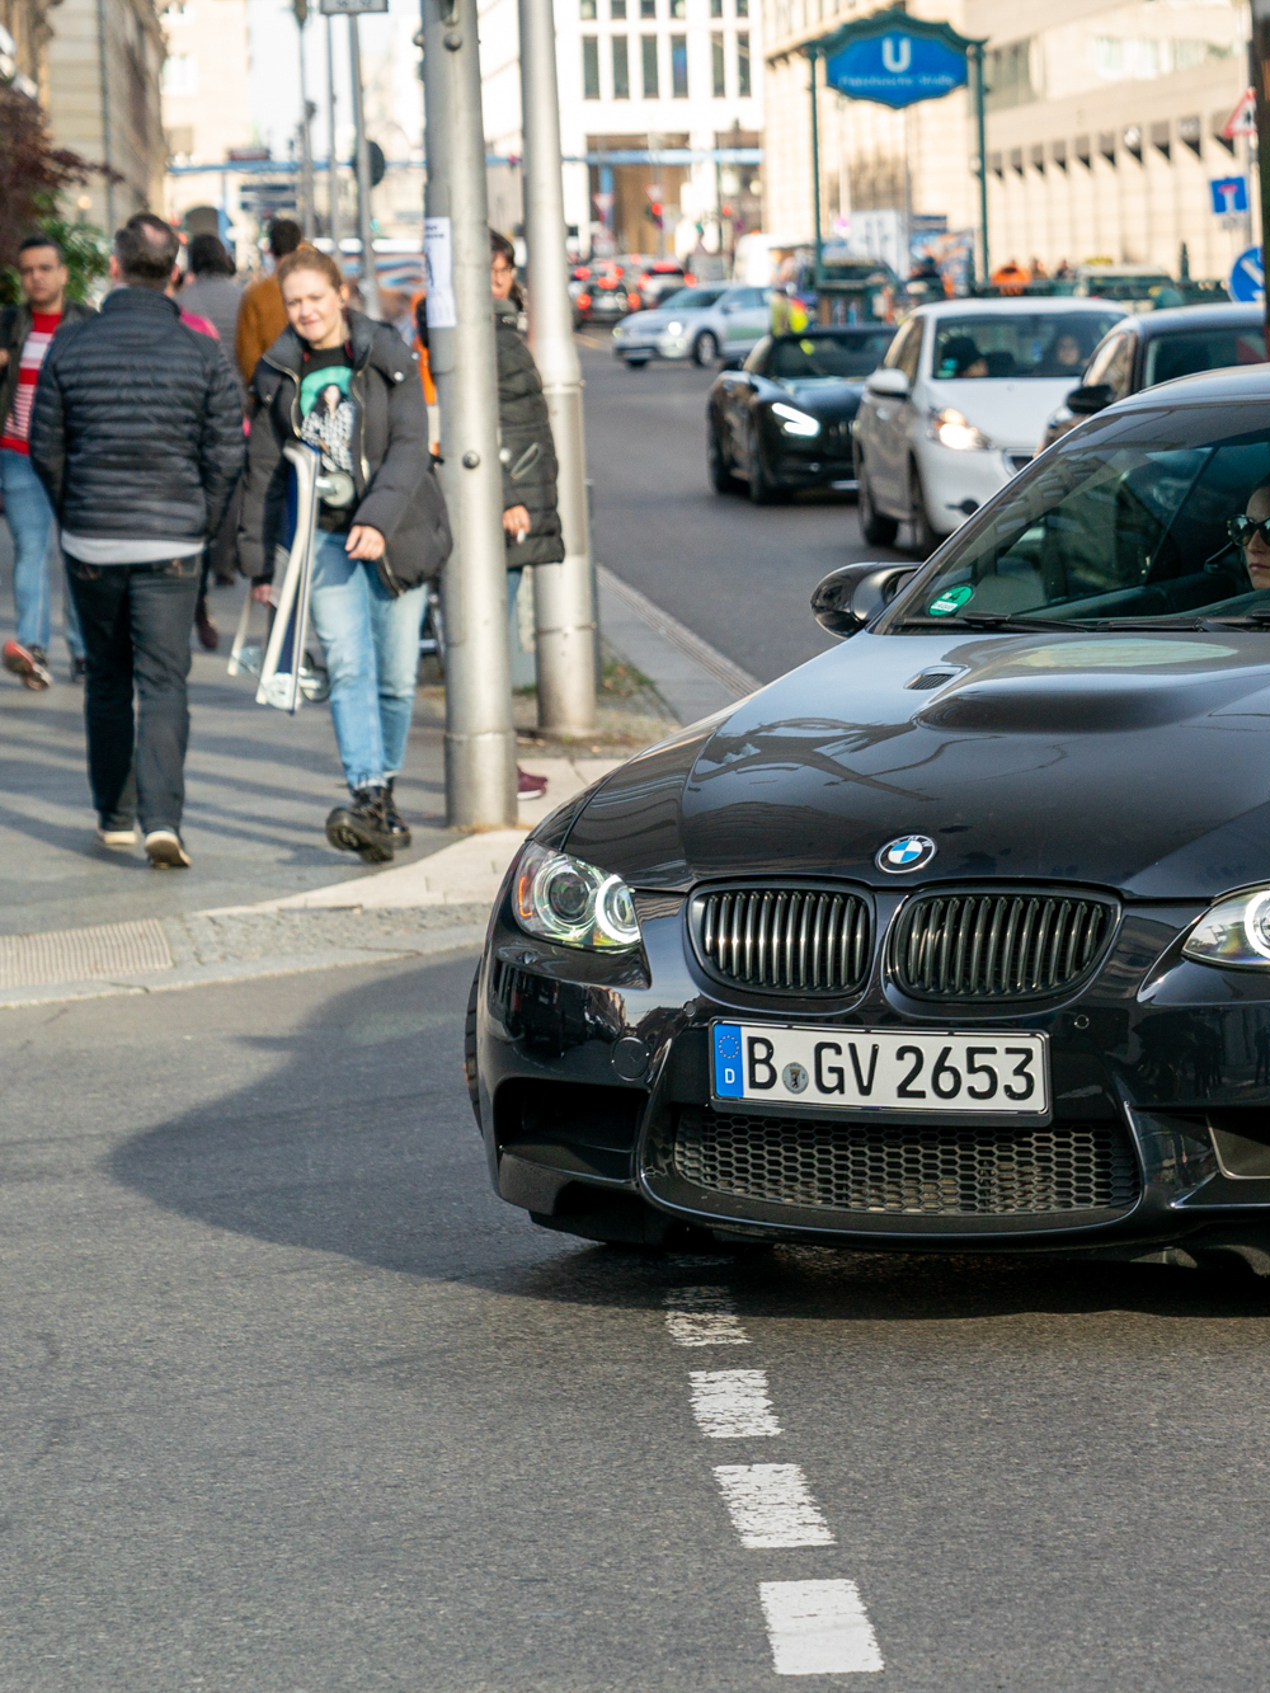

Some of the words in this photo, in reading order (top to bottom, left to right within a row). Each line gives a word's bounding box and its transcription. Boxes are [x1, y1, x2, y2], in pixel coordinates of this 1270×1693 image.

[882, 37, 911, 73] U
[724, 1068, 735, 1083] D
[747, 1036, 777, 1089] B
[814, 1042, 879, 1096] GV
[896, 1045, 1035, 1101] 2653
